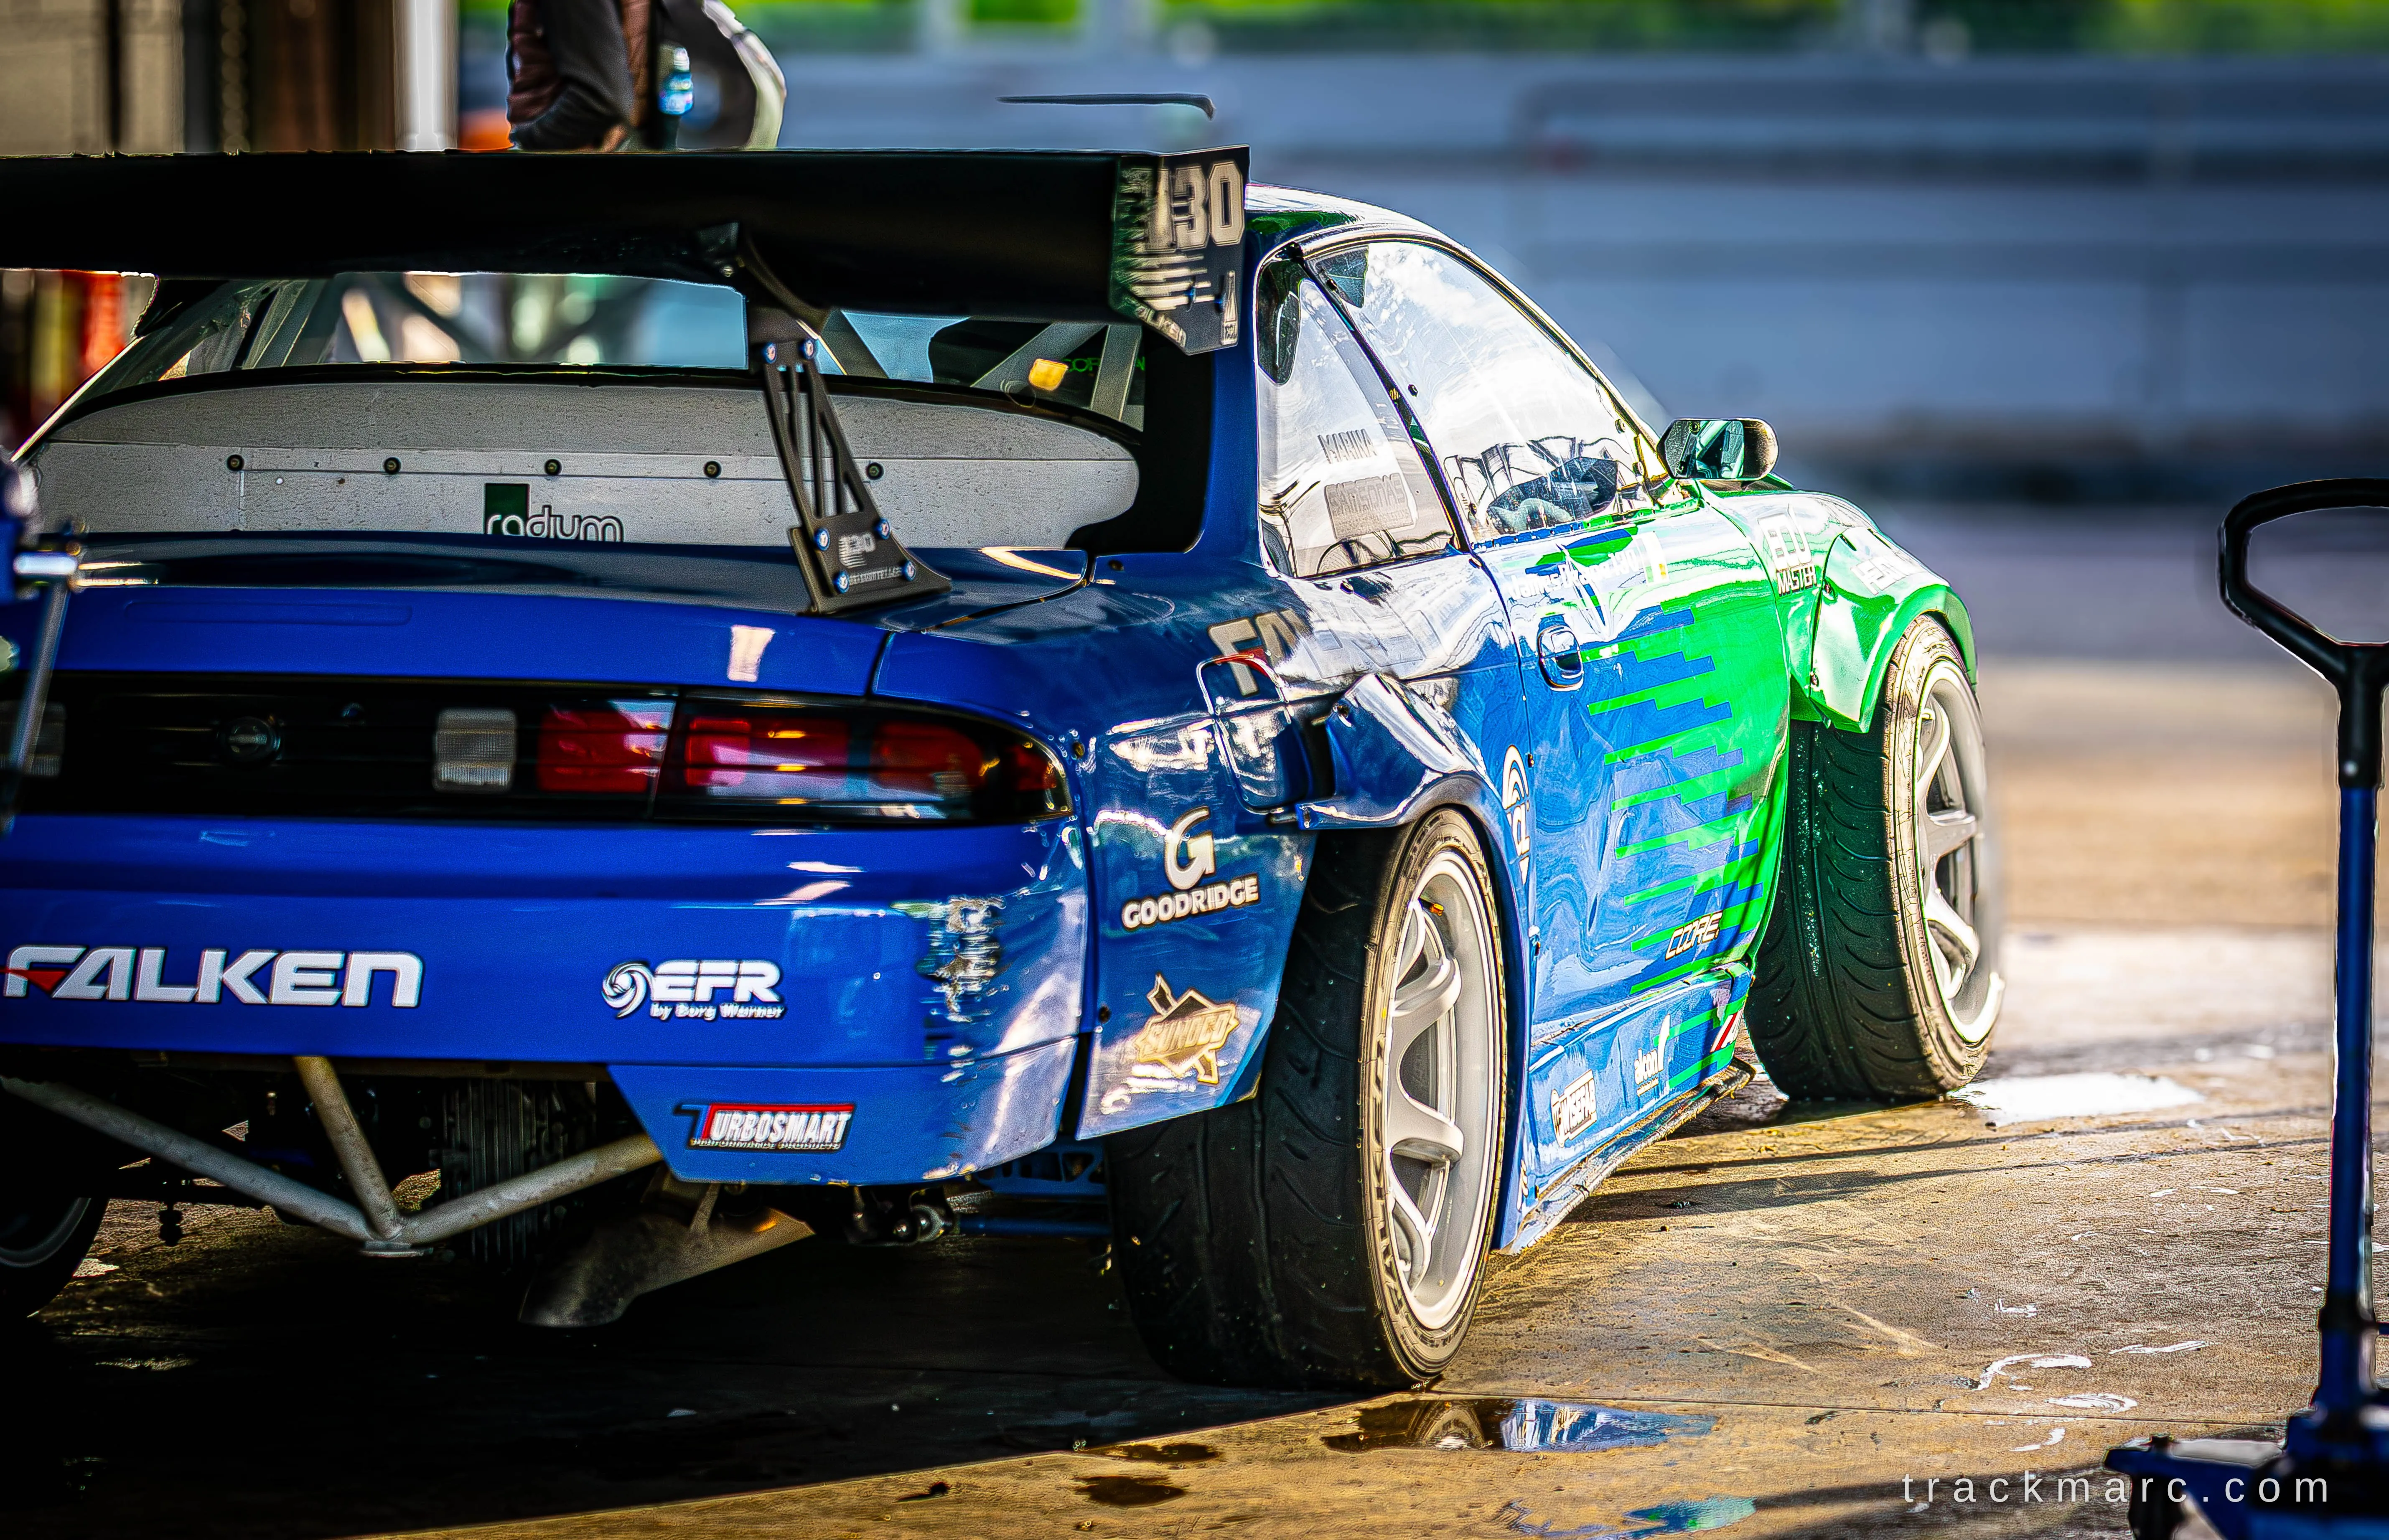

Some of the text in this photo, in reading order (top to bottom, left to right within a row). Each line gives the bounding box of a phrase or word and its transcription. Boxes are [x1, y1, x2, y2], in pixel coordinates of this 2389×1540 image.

[1776, 565, 1818, 597] MASTER
[1122, 876, 1259, 929] GOODRIDGE
[4, 945, 423, 1007] FALKEN
[651, 960, 781, 1002] EFR
[650, 1003, 785, 1021] by Borg Warner
[1634, 1048, 1658, 1085] alcon
[674, 1103, 853, 1144] TURBOSMART
